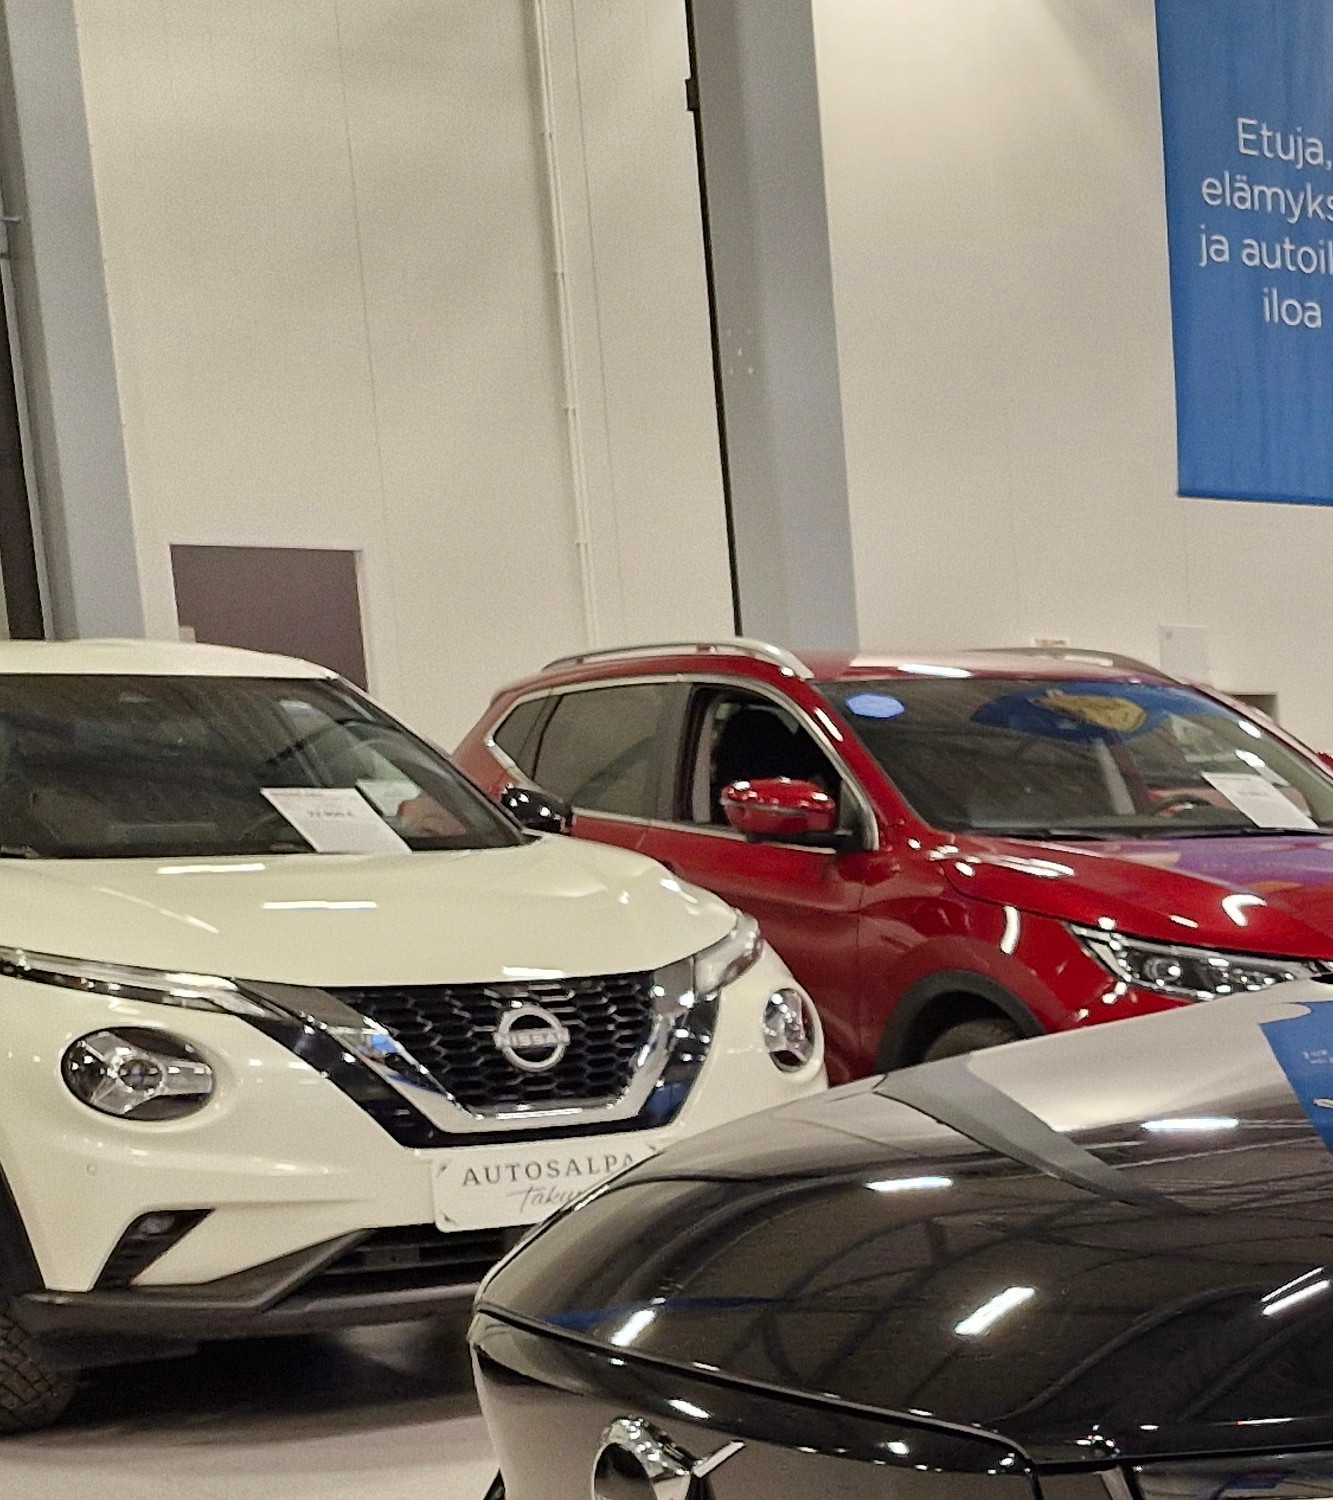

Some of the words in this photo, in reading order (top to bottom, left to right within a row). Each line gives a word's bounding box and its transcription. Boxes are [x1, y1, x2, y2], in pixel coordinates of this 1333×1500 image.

[1237, 117, 1332, 170] Etuja,
[1199, 224, 1230, 267] ja
[1262, 287, 1323, 329] iloa
